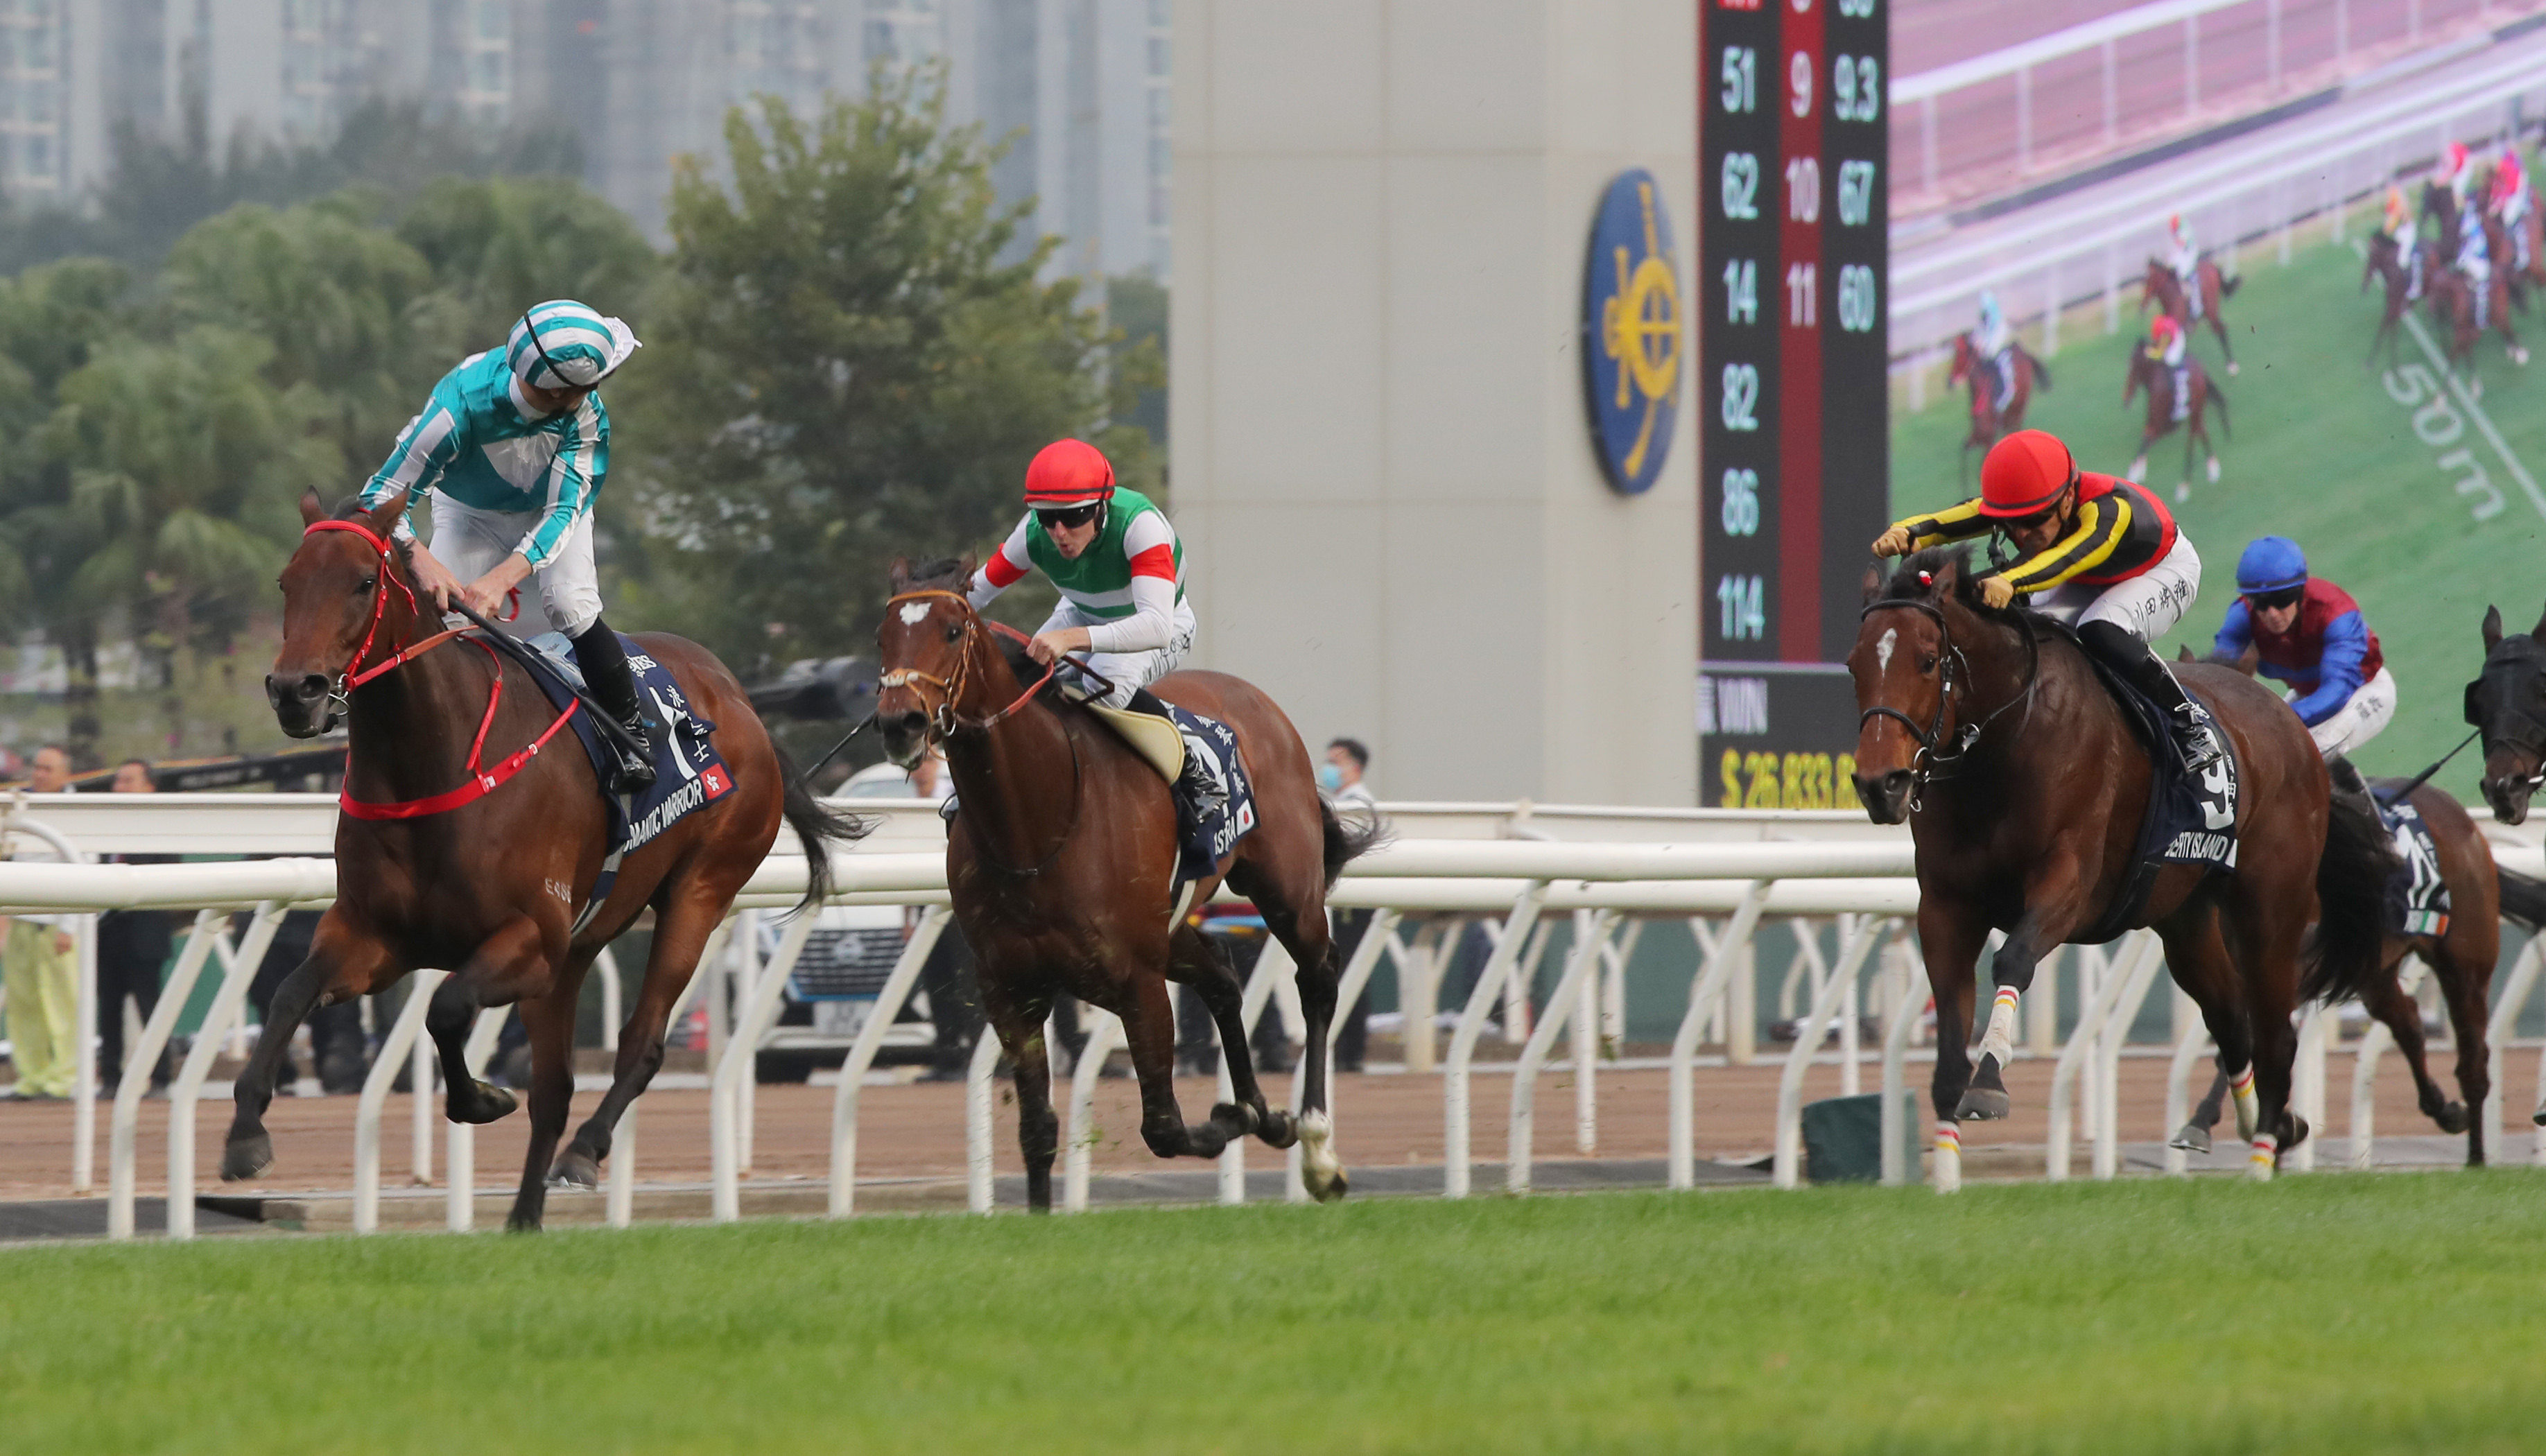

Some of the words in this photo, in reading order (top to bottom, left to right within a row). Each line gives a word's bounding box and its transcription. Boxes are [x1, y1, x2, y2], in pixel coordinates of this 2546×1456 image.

[1722, 46, 1756, 113] 51
[1791, 52, 1812, 118] 9
[1722, 153, 1759, 220] 62
[1786, 157, 1820, 223] 10
[1838, 159, 1876, 226] 67
[1723, 259, 1758, 324] 14
[1787, 263, 1816, 327] 11
[1838, 264, 1876, 333] 60
[1722, 363, 1759, 431] 82
[2382, 363, 2505, 520] 50m
[1722, 469, 1760, 537] 86
[1717, 575, 1765, 640] 114
[660, 780, 704, 830] WARRIOR
[2190, 833, 2229, 862] ISLAND
